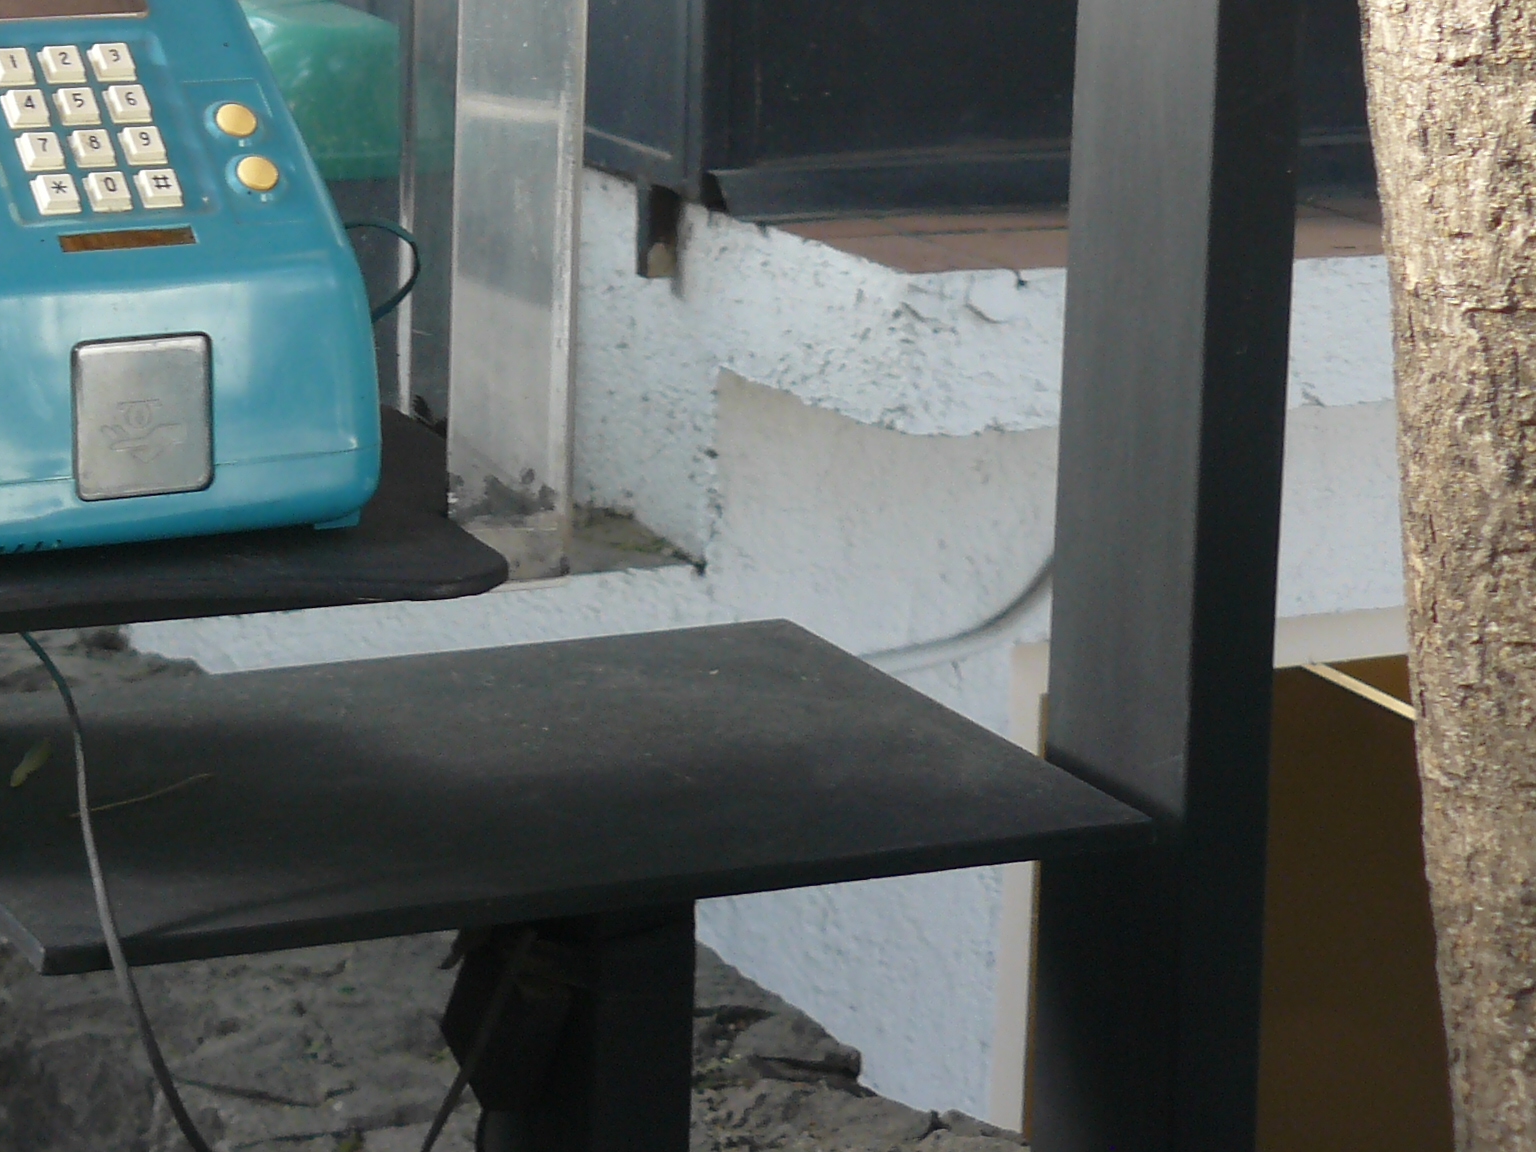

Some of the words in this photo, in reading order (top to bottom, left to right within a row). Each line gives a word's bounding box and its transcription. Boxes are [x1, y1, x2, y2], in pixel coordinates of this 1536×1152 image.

[10, 55, 18, 69] 1
[58, 52, 71, 65] 2
[109, 49, 120, 62] 3
[24, 95, 35, 109] 4
[72, 93, 84, 107] 5
[125, 92, 136, 106] 6
[37, 138, 47, 152] 7
[88, 136, 100, 149] 8
[138, 132, 150, 146] 9
[104, 177, 117, 192] 0
